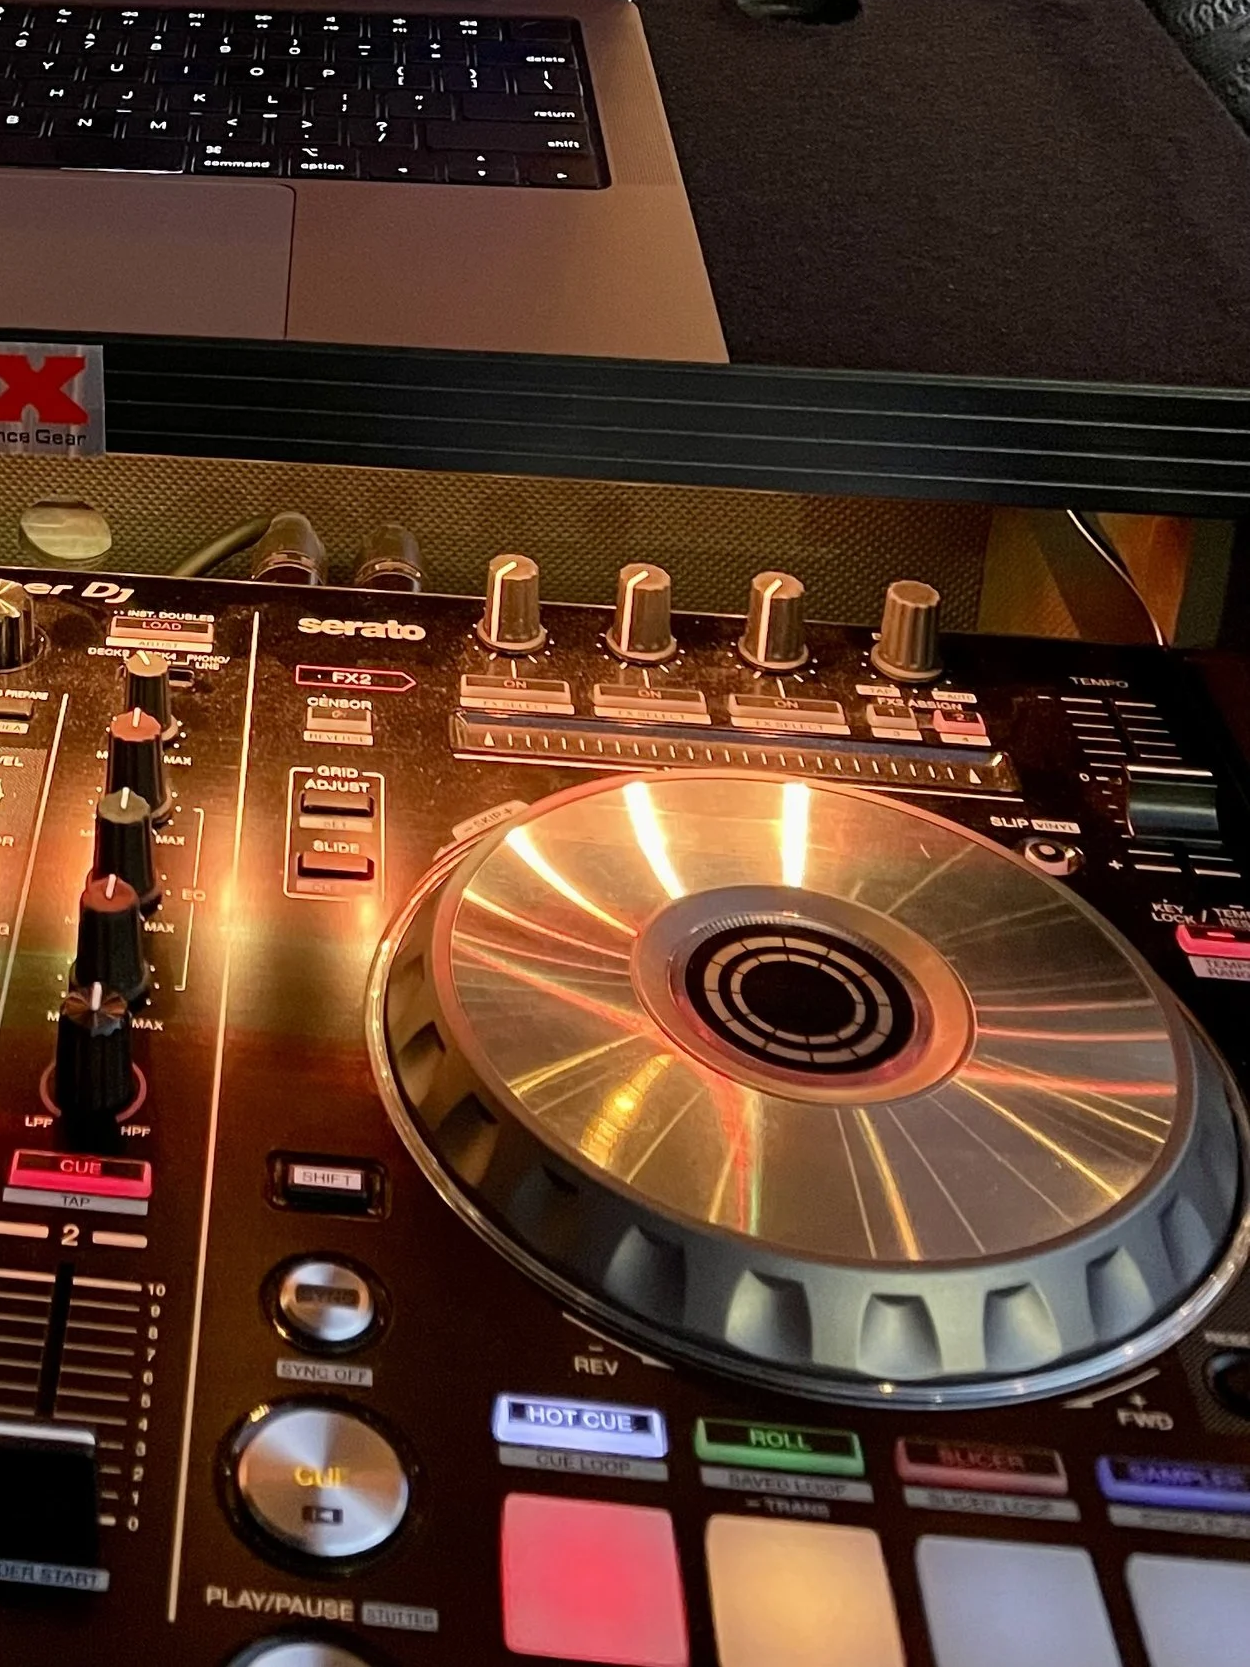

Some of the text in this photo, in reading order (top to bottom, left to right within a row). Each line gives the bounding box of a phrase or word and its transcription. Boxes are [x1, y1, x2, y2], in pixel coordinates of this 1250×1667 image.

[526, 55, 565, 63] delete
[193, 93, 206, 102] K
[267, 95, 278, 104] L
[534, 110, 575, 118] return
[77, 118, 92, 127] N
[150, 121, 167, 129] M
[204, 160, 270, 168] command
[300, 162, 344, 171] option
[35, 429, 87, 447] Gear
[142, 621, 182, 630] LOAD
[297, 616, 426, 641] serato
[332, 671, 372, 686] FX2
[503, 679, 527, 689] ON
[1069, 676, 1129, 689] TEMPO
[4, 690, 49, 701] PREPARE
[307, 697, 372, 710] CENSOR
[773, 699, 799, 710] ON
[908, 699, 962, 711] ASSIGN
[163, 755, 192, 766] MAX
[316, 765, 359, 779] GRID
[304, 778, 370, 793] ADJUST
[990, 816, 1029, 829] SLIP
[156, 835, 184, 846] MAX
[312, 839, 360, 853] SLIDE
[1151, 902, 1184, 914] KEY
[1151, 912, 1197, 925] LOCK
[144, 922, 175, 934] MAX
[132, 1019, 163, 1031] MAX
[25, 1115, 53, 1128] LPF
[121, 1126, 151, 1138] HPF
[60, 1159, 102, 1175] CUE
[302, 1171, 352, 1186] SHIFT
[61, 1195, 91, 1207] TAP
[61, 1224, 80, 1247] 2
[281, 1363, 330, 1380] SYNC
[574, 1355, 620, 1377] REV
[527, 1404, 634, 1432] HOT CUE
[1117, 1408, 1174, 1431] FWD
[750, 1428, 812, 1452] ROLL
[536, 1453, 632, 1475] CUE LOOP
[40, 1567, 100, 1589] START
[206, 1586, 355, 1622] PLAY/PAUSE
